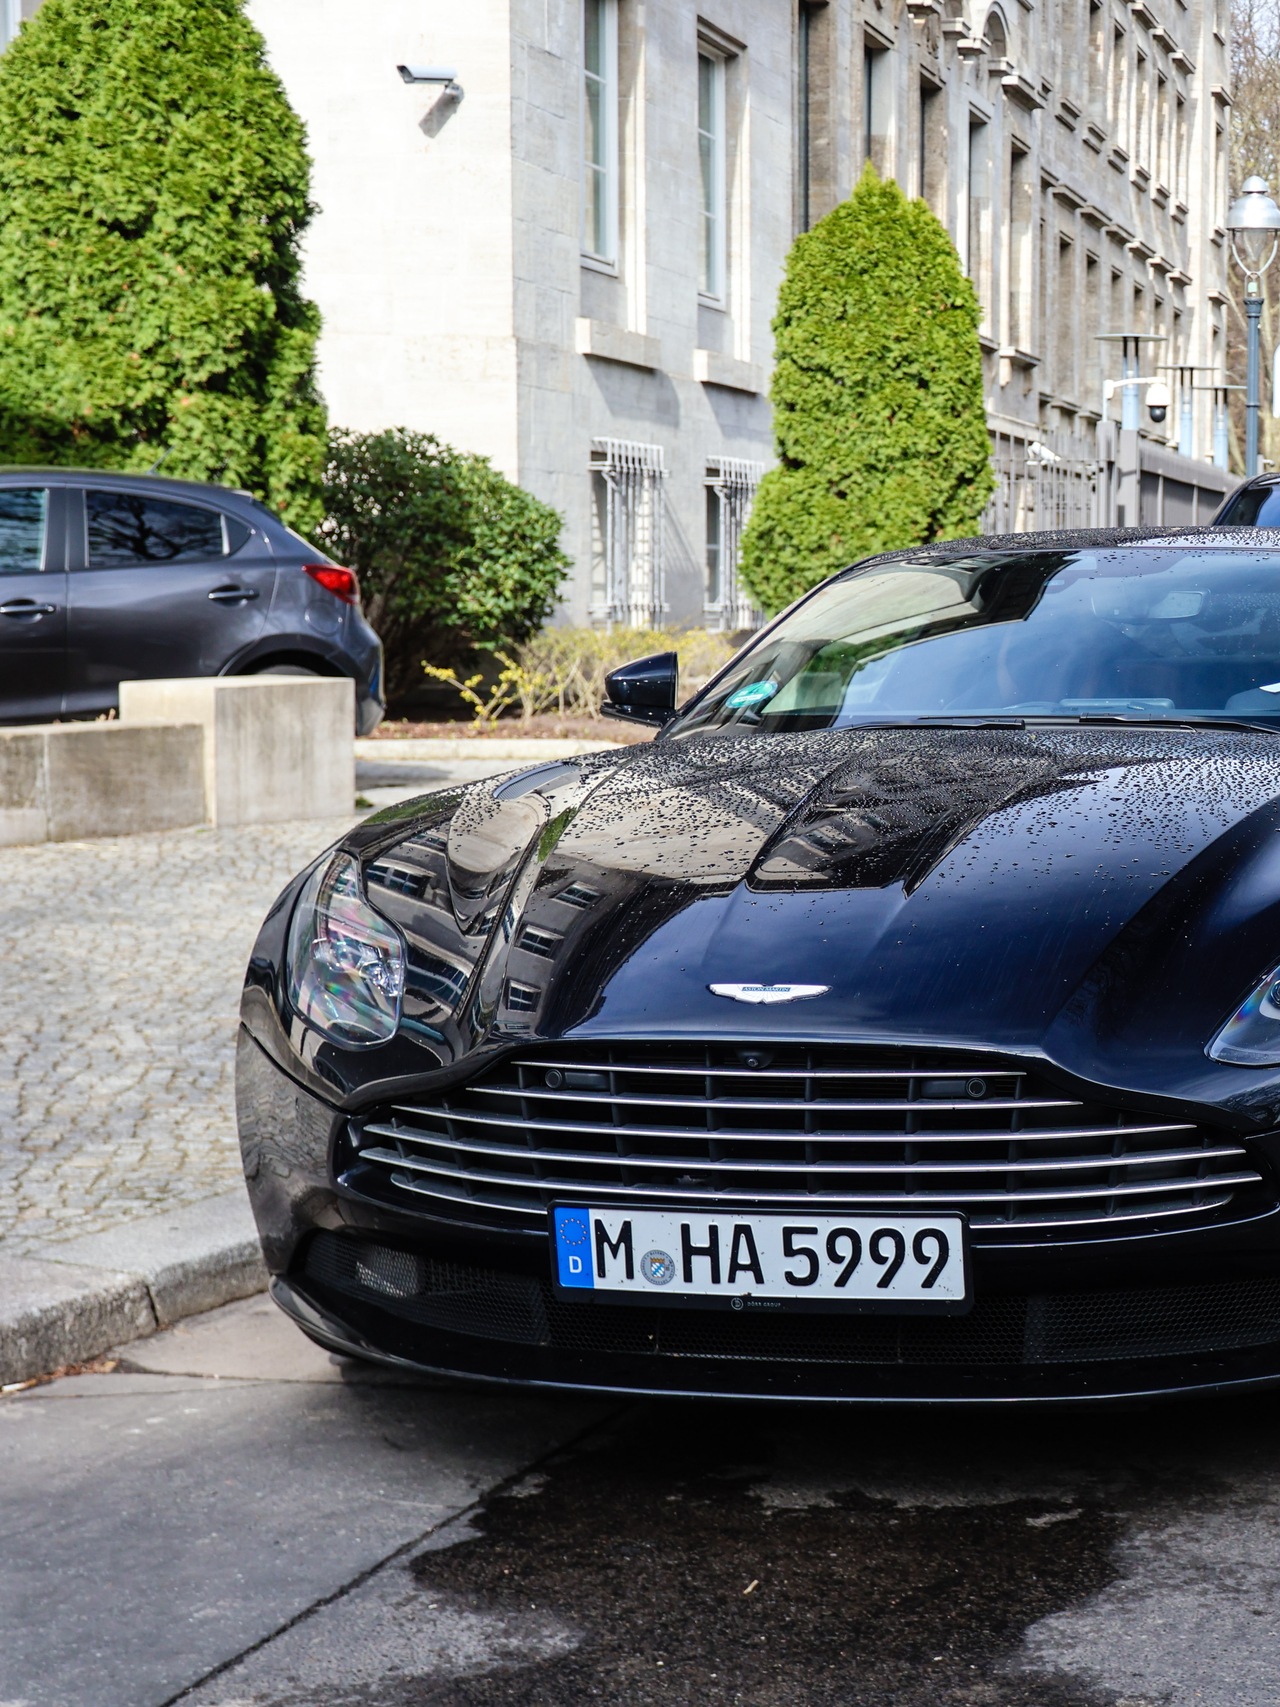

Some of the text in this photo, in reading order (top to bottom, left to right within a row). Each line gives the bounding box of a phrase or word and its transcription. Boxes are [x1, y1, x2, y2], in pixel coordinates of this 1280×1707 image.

[568, 1256, 582, 1274] D
[594, 1218, 634, 1280] M
[680, 1222, 765, 1285] HA
[782, 1226, 950, 1289] 5999
